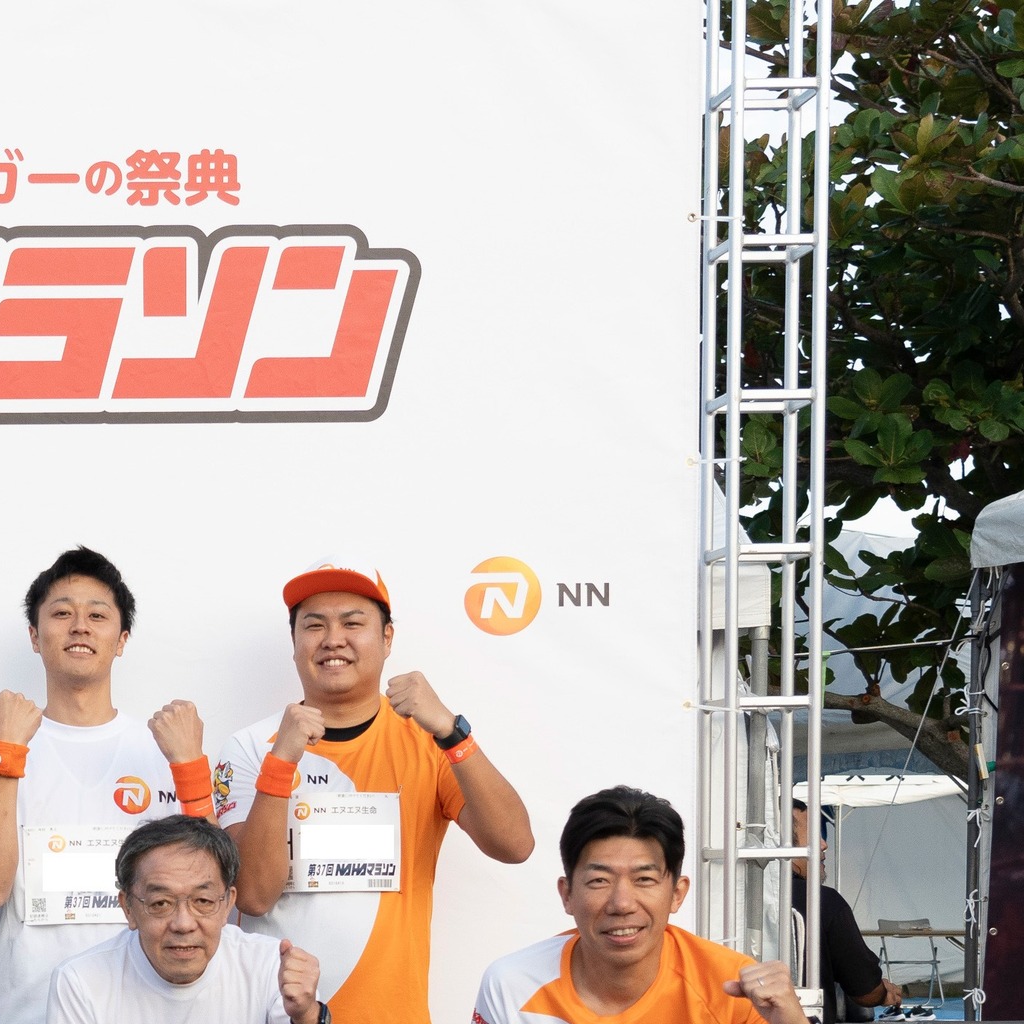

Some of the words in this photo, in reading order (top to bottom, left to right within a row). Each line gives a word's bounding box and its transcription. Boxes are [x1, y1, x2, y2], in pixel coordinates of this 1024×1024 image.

[556, 582, 610, 607] NN
[307, 774, 328, 785] NN
[331, 805, 377, 815] エヌエヌ生命
[69, 839, 82, 847] NN
[307, 863, 335, 877] 第37回
[336, 863, 396, 877] NAHAマラソン
[64, 895, 90, 909] 第37回
